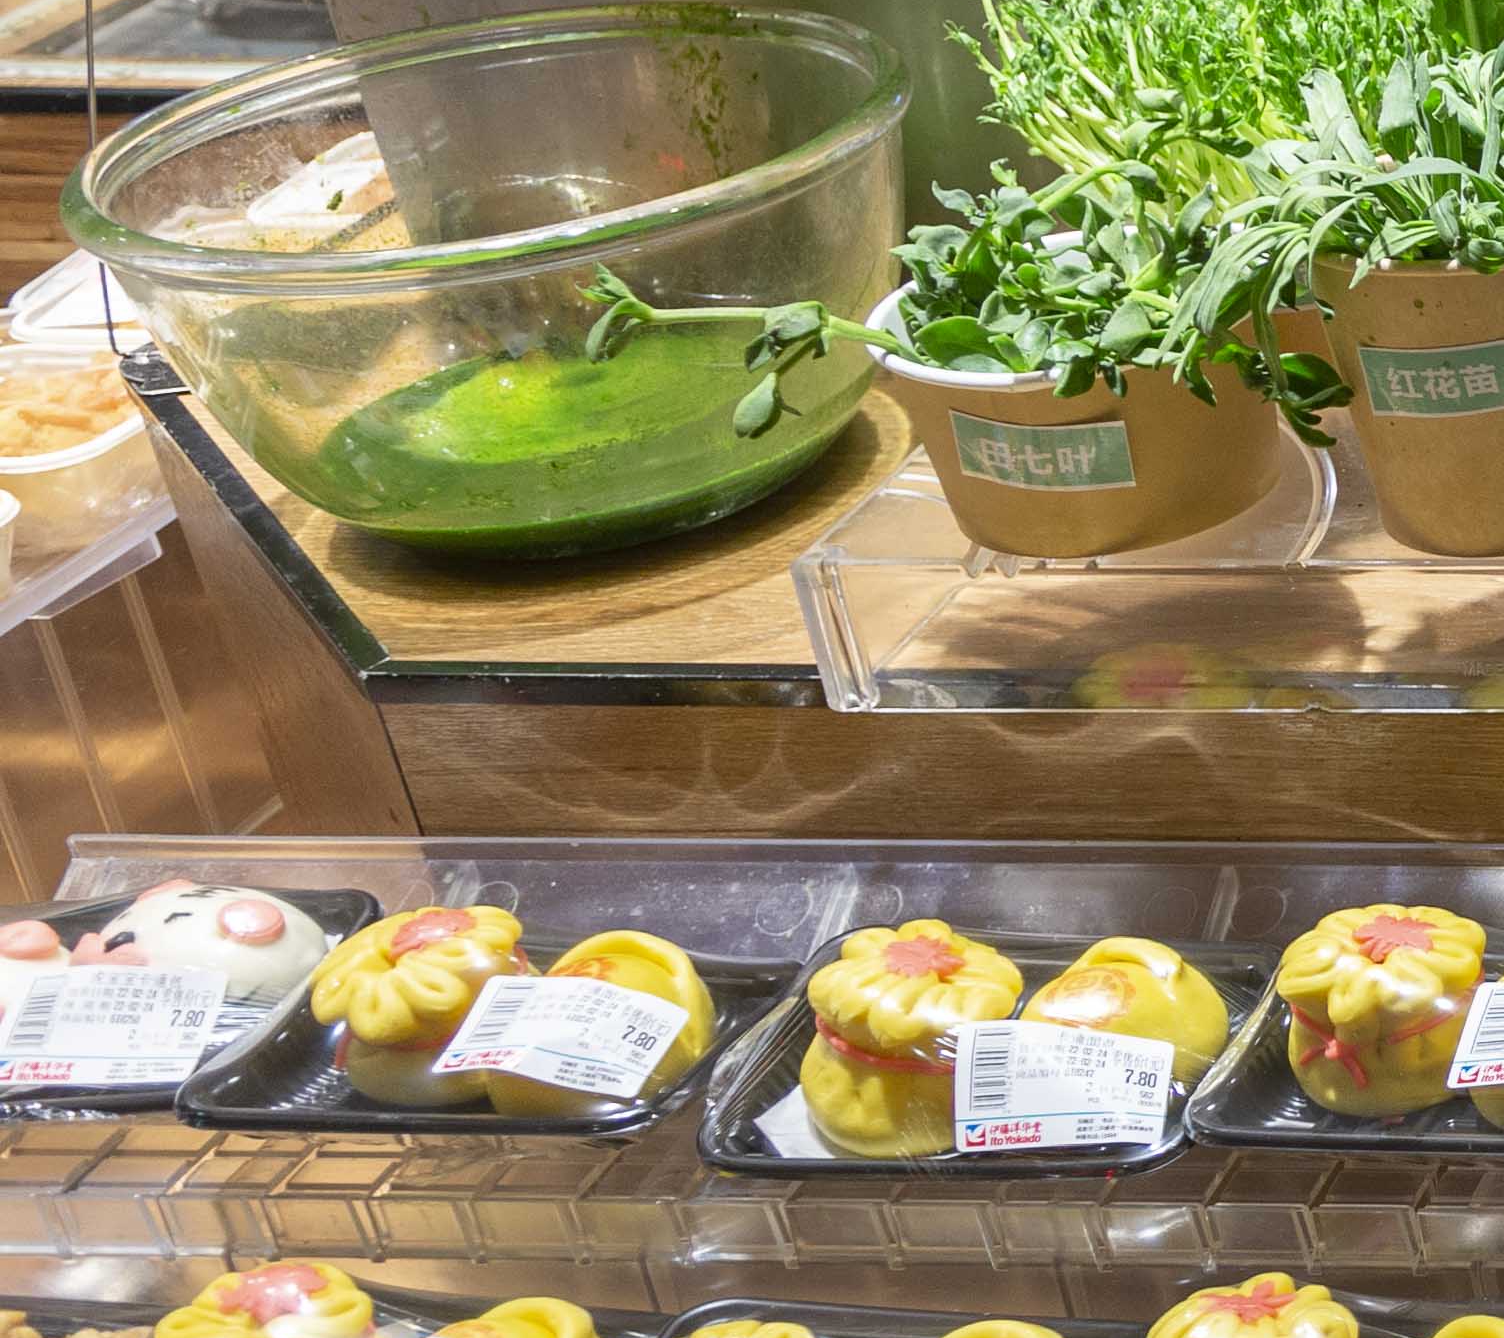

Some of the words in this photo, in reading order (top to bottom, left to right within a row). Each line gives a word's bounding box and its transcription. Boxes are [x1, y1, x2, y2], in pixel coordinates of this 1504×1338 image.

[1386, 362, 1501, 401] 红花苗
[977, 437, 1097, 477] 田七叶
[169, 1009, 206, 1028] 7.80
[621, 1025, 657, 1051] 7.80
[1123, 1069, 1158, 1088] 7.80
